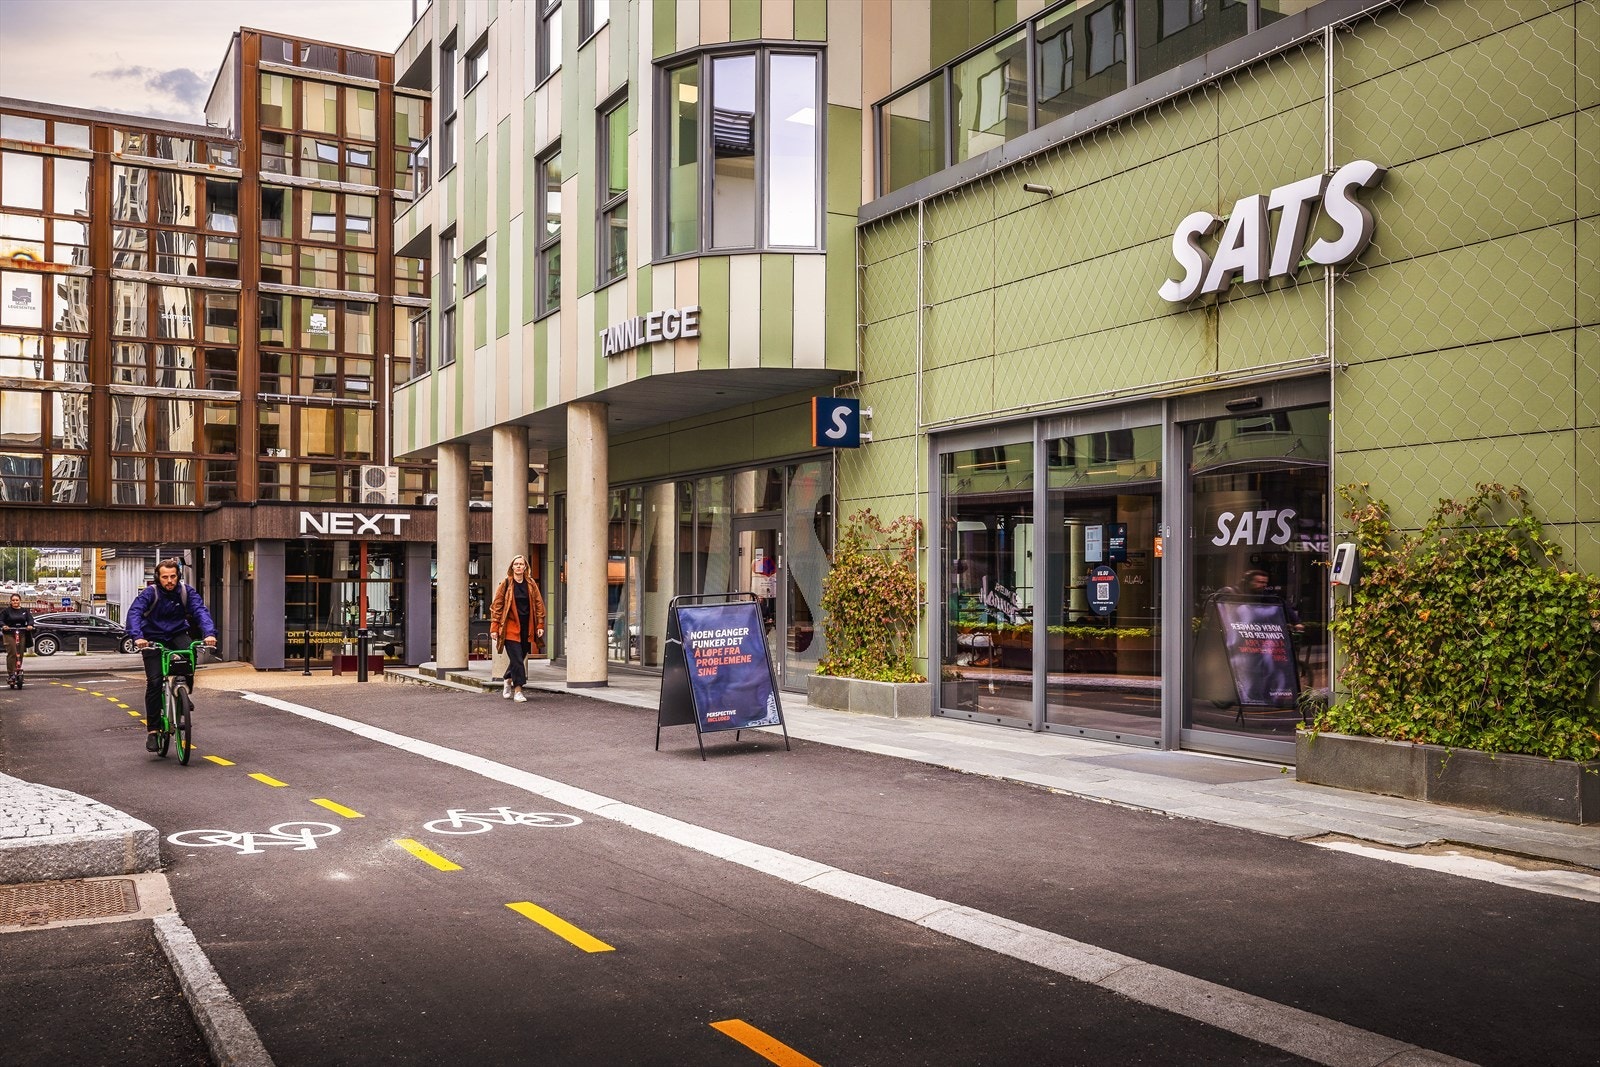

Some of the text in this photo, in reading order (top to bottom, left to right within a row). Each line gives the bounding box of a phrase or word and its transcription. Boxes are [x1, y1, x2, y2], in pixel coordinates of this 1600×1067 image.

[1158, 160, 1384, 303] SATS
[599, 305, 699, 358] TANNLEGE
[825, 406, 853, 439] S
[300, 511, 410, 536] NEXT
[1211, 509, 1297, 547] SATS
[690, 627, 749, 640] NOEN GANGER
[692, 637, 743, 649] FUNKER DET
[694, 646, 741, 658] Å LØPE FRA
[696, 655, 752, 667] PROBLEMENE
[698, 667, 717, 677] SINE
[706, 710, 736, 718] PERSPECTIVE
